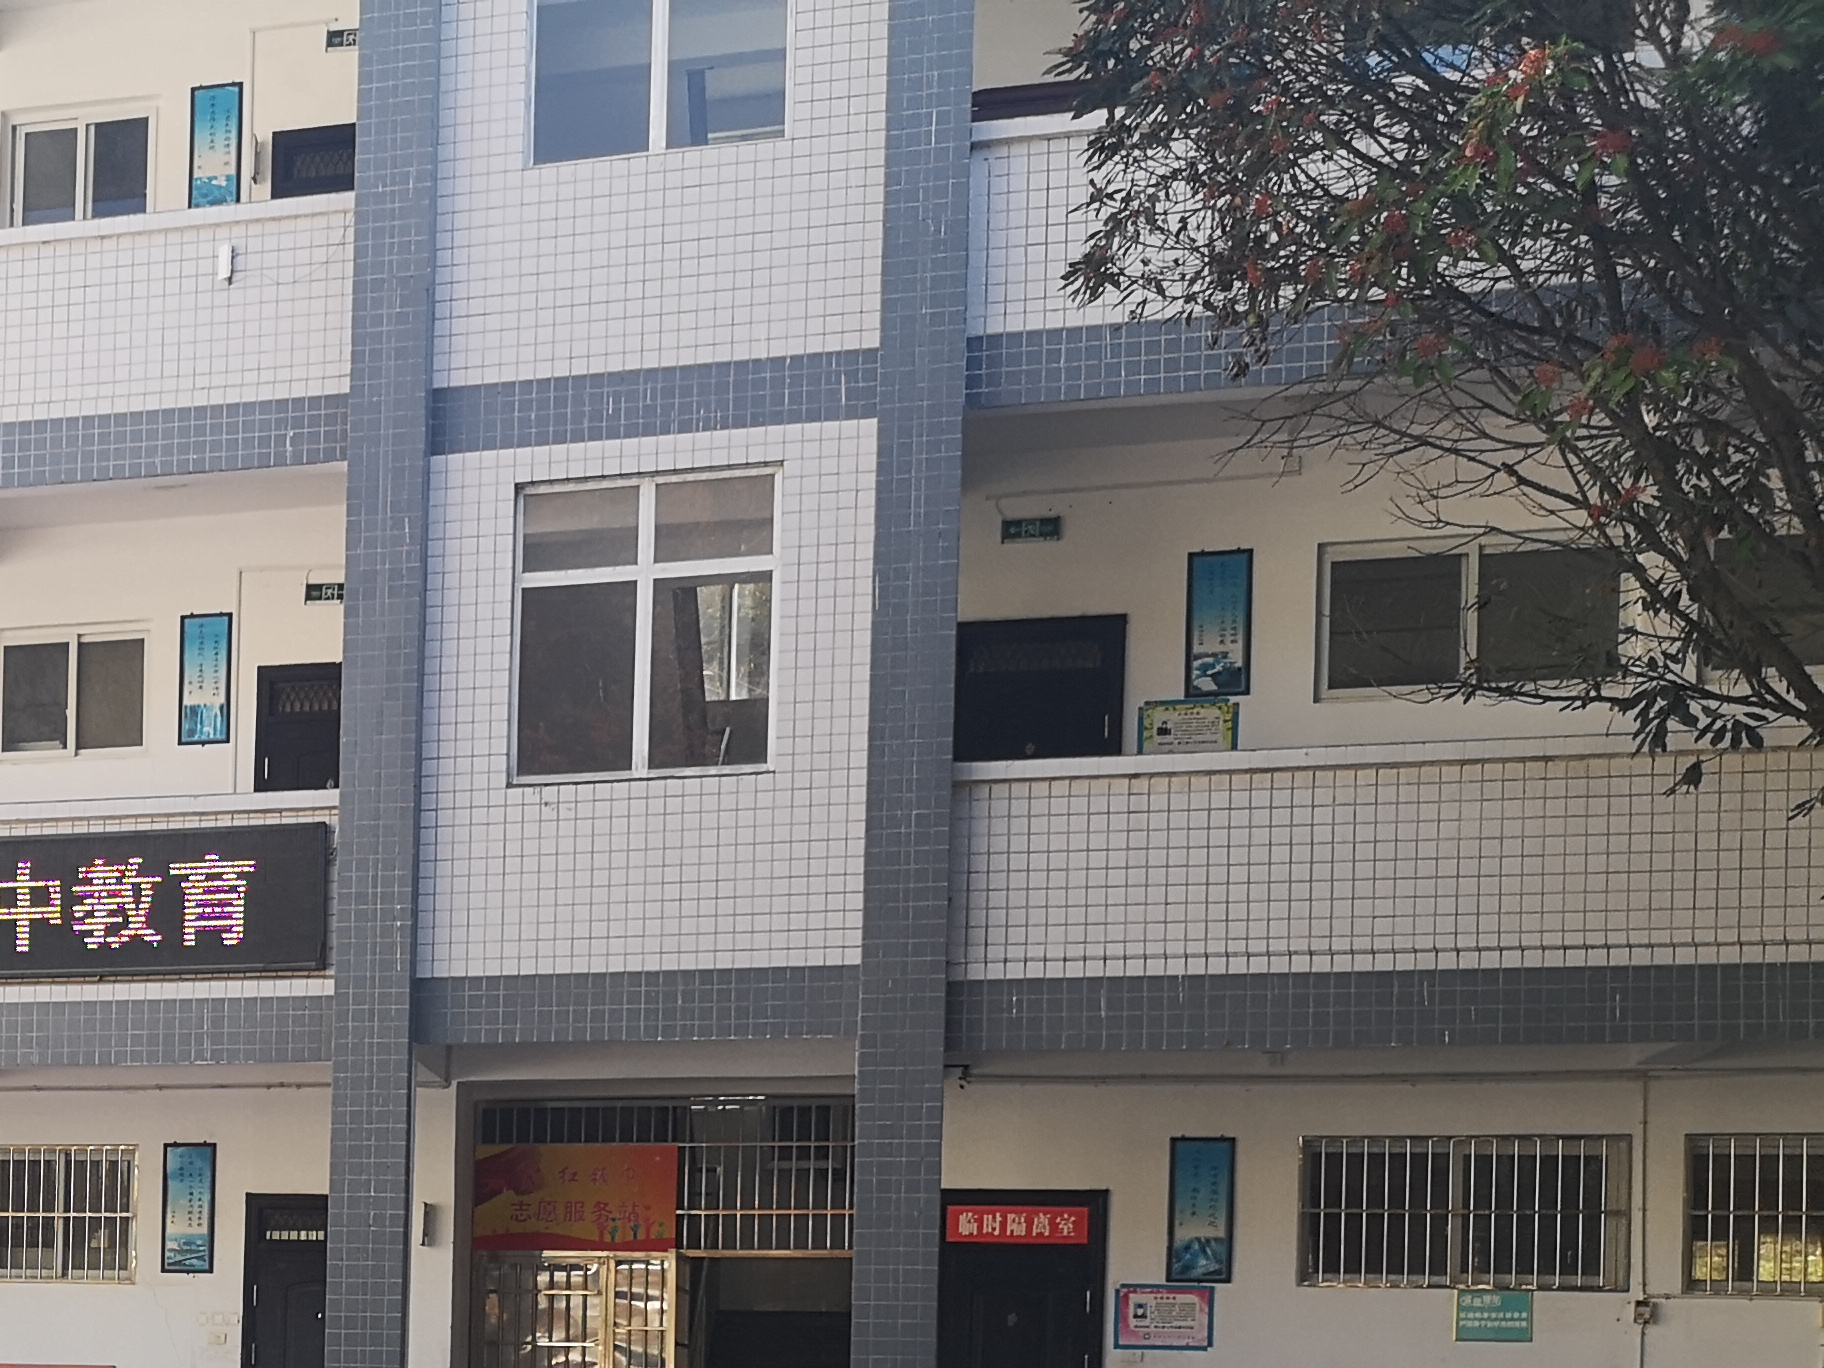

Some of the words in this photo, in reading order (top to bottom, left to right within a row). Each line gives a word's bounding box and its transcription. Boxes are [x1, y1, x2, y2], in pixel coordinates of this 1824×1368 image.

[510, 1200, 640, 1224] 志愿服务站
[958, 1211, 1076, 1237] 临时隔离室
